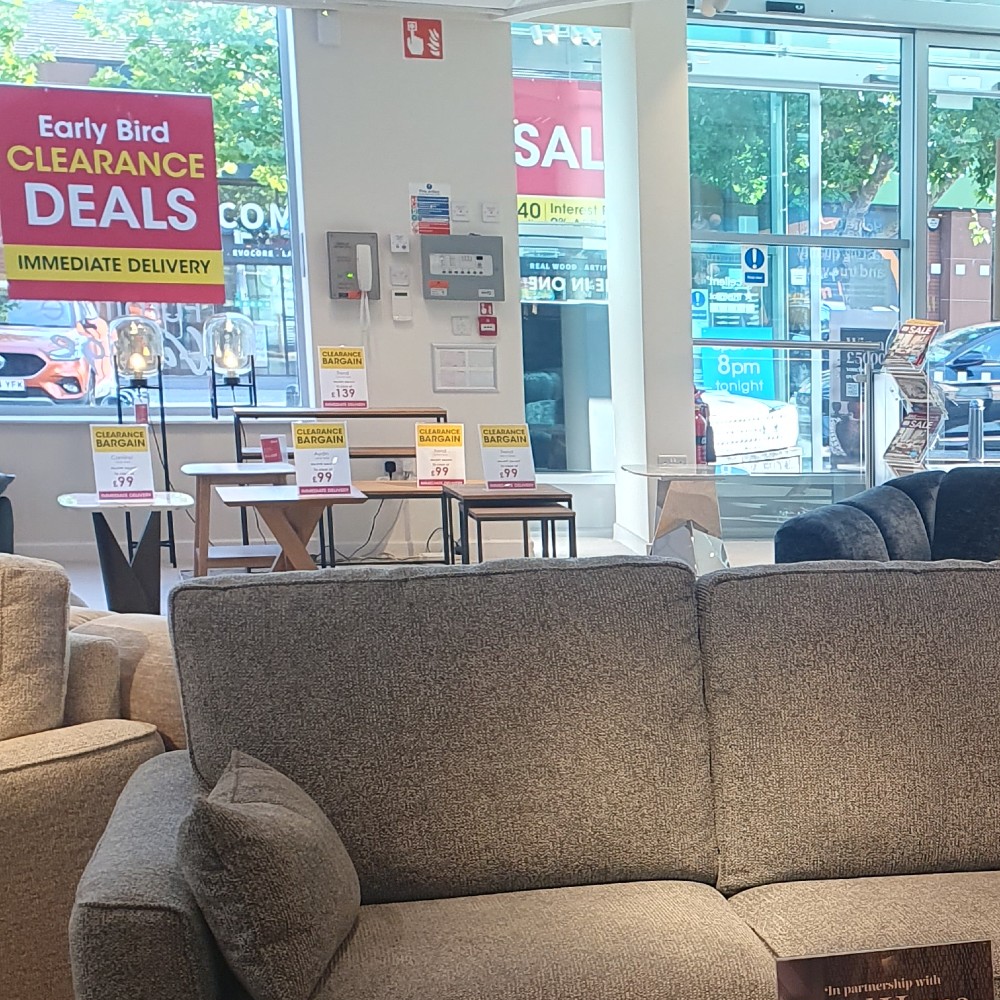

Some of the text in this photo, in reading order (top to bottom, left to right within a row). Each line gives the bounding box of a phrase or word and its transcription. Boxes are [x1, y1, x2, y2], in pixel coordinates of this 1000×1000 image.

[38, 114, 170, 144] Early Bird
[6, 145, 205, 179] CLEARANCE
[24, 182, 198, 231] DEALS
[518, 202, 541, 219] 40
[550, 203, 597, 216] Interest
[18, 254, 211, 274] IMMEDIATE DELIVERY
[529, 262, 550, 270] REAL
[551, 263, 578, 271] WOOD
[908, 325, 934, 335] SALE
[717, 354, 761, 377] 8pm
[715, 379, 764, 394] tonight
[331, 388, 355, 398] £139
[908, 420, 933, 429] SALE
[96, 439, 146, 448] BARGAIN
[297, 435, 344, 444] BARGAIN
[431, 467, 449, 476] £99
[499, 468, 518, 478] £99
[113, 476, 134, 487] £99
[312, 472, 332, 483] £99
[824, 975, 942, 997] In partnership with
